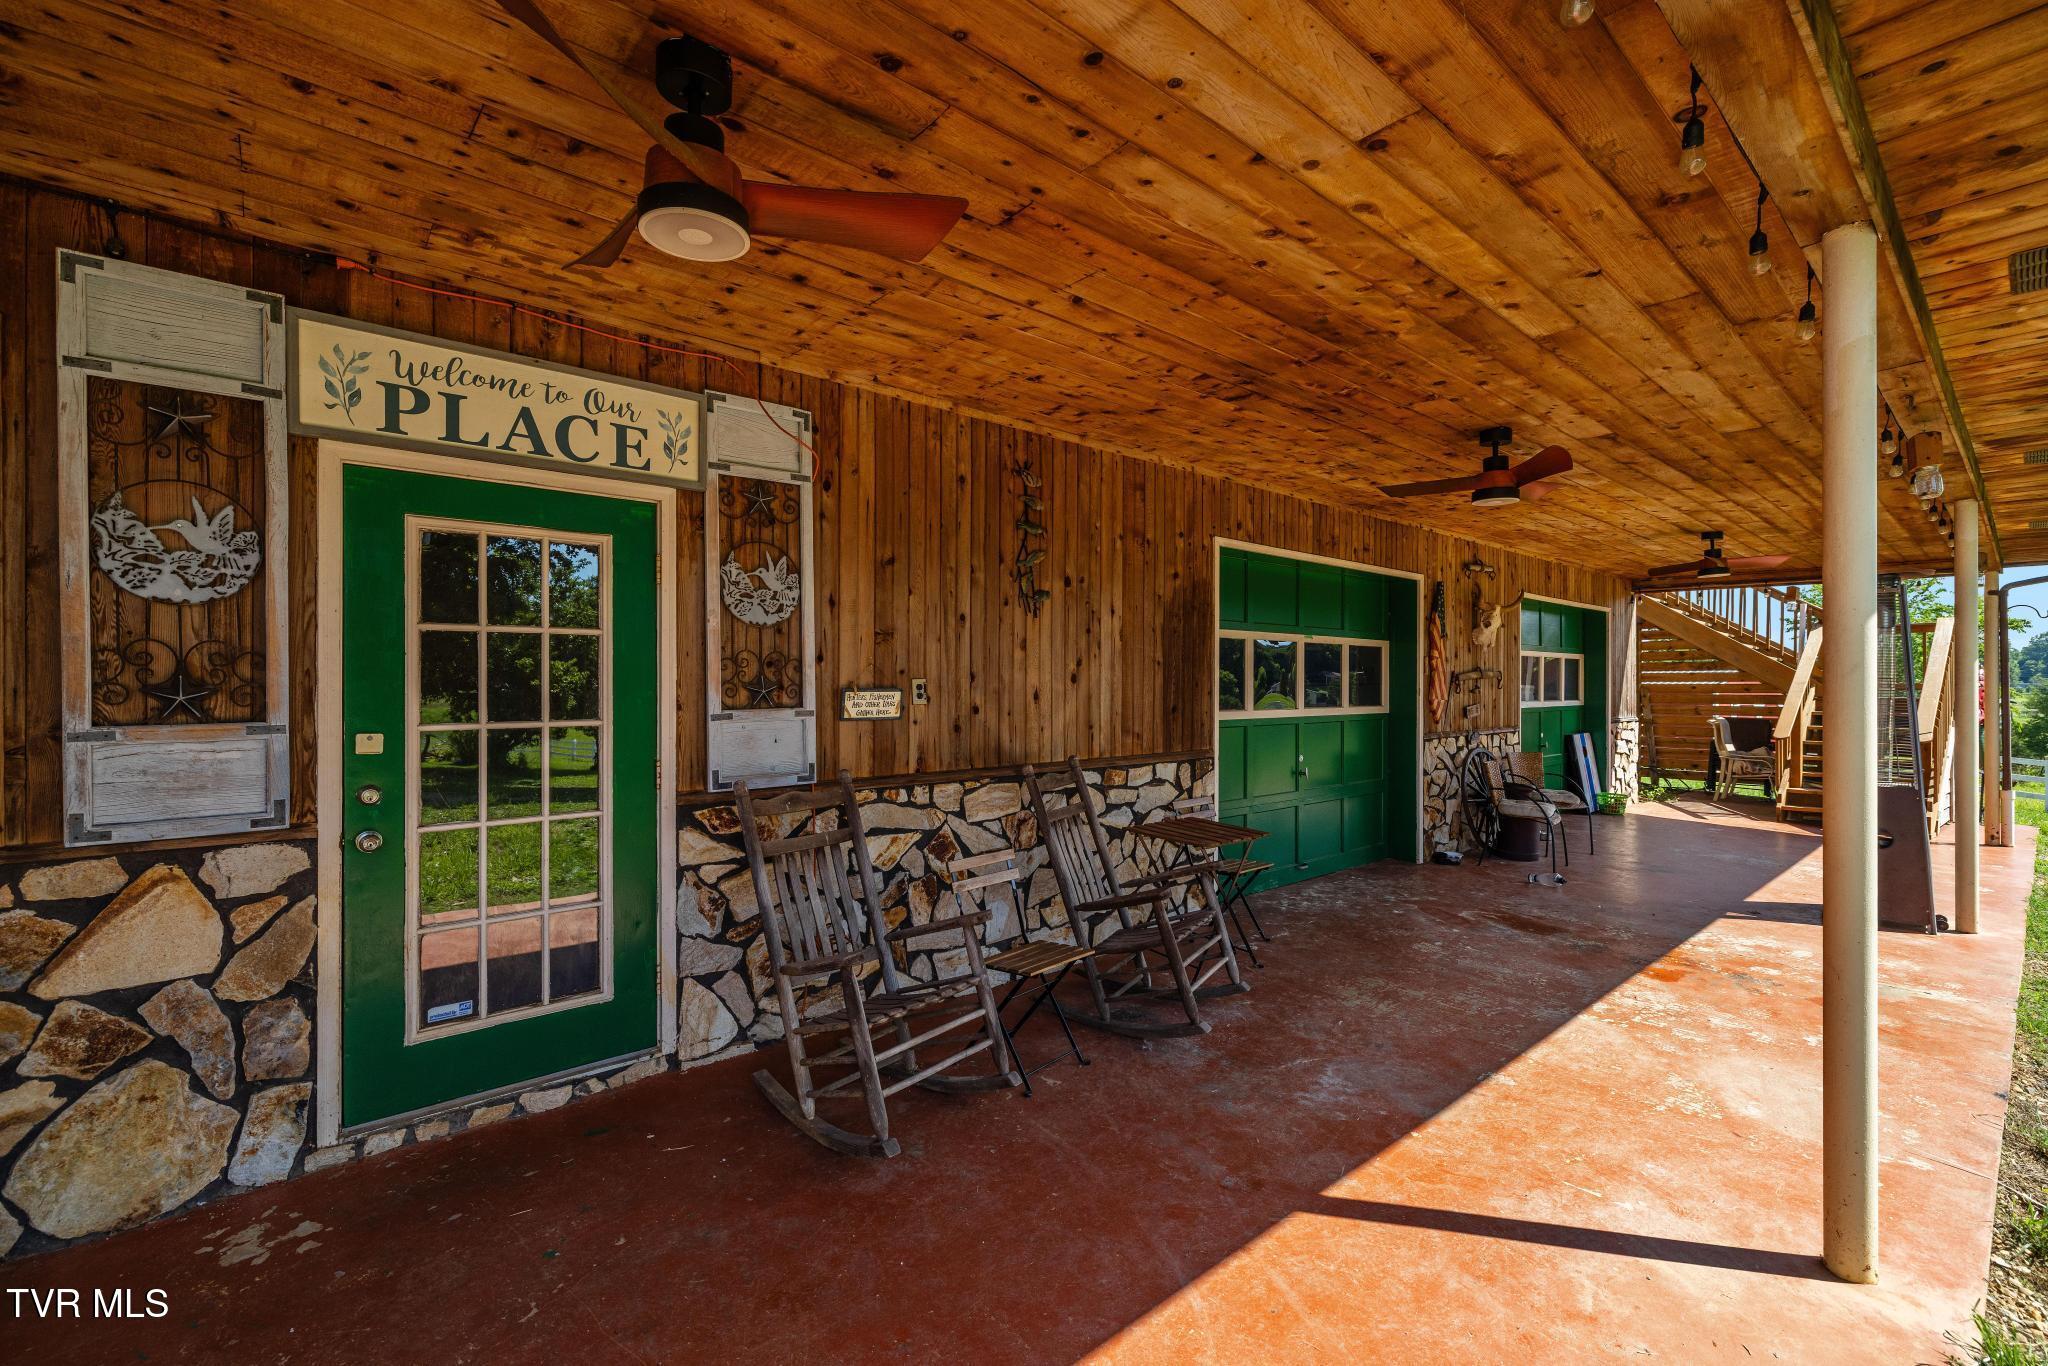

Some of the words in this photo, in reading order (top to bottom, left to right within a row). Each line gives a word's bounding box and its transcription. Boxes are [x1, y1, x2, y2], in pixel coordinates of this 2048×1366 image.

[376, 380, 651, 472] PLACE
[389, 349, 536, 399] Welcome
[544, 381, 574, 406] to
[583, 387, 642, 423] Our
